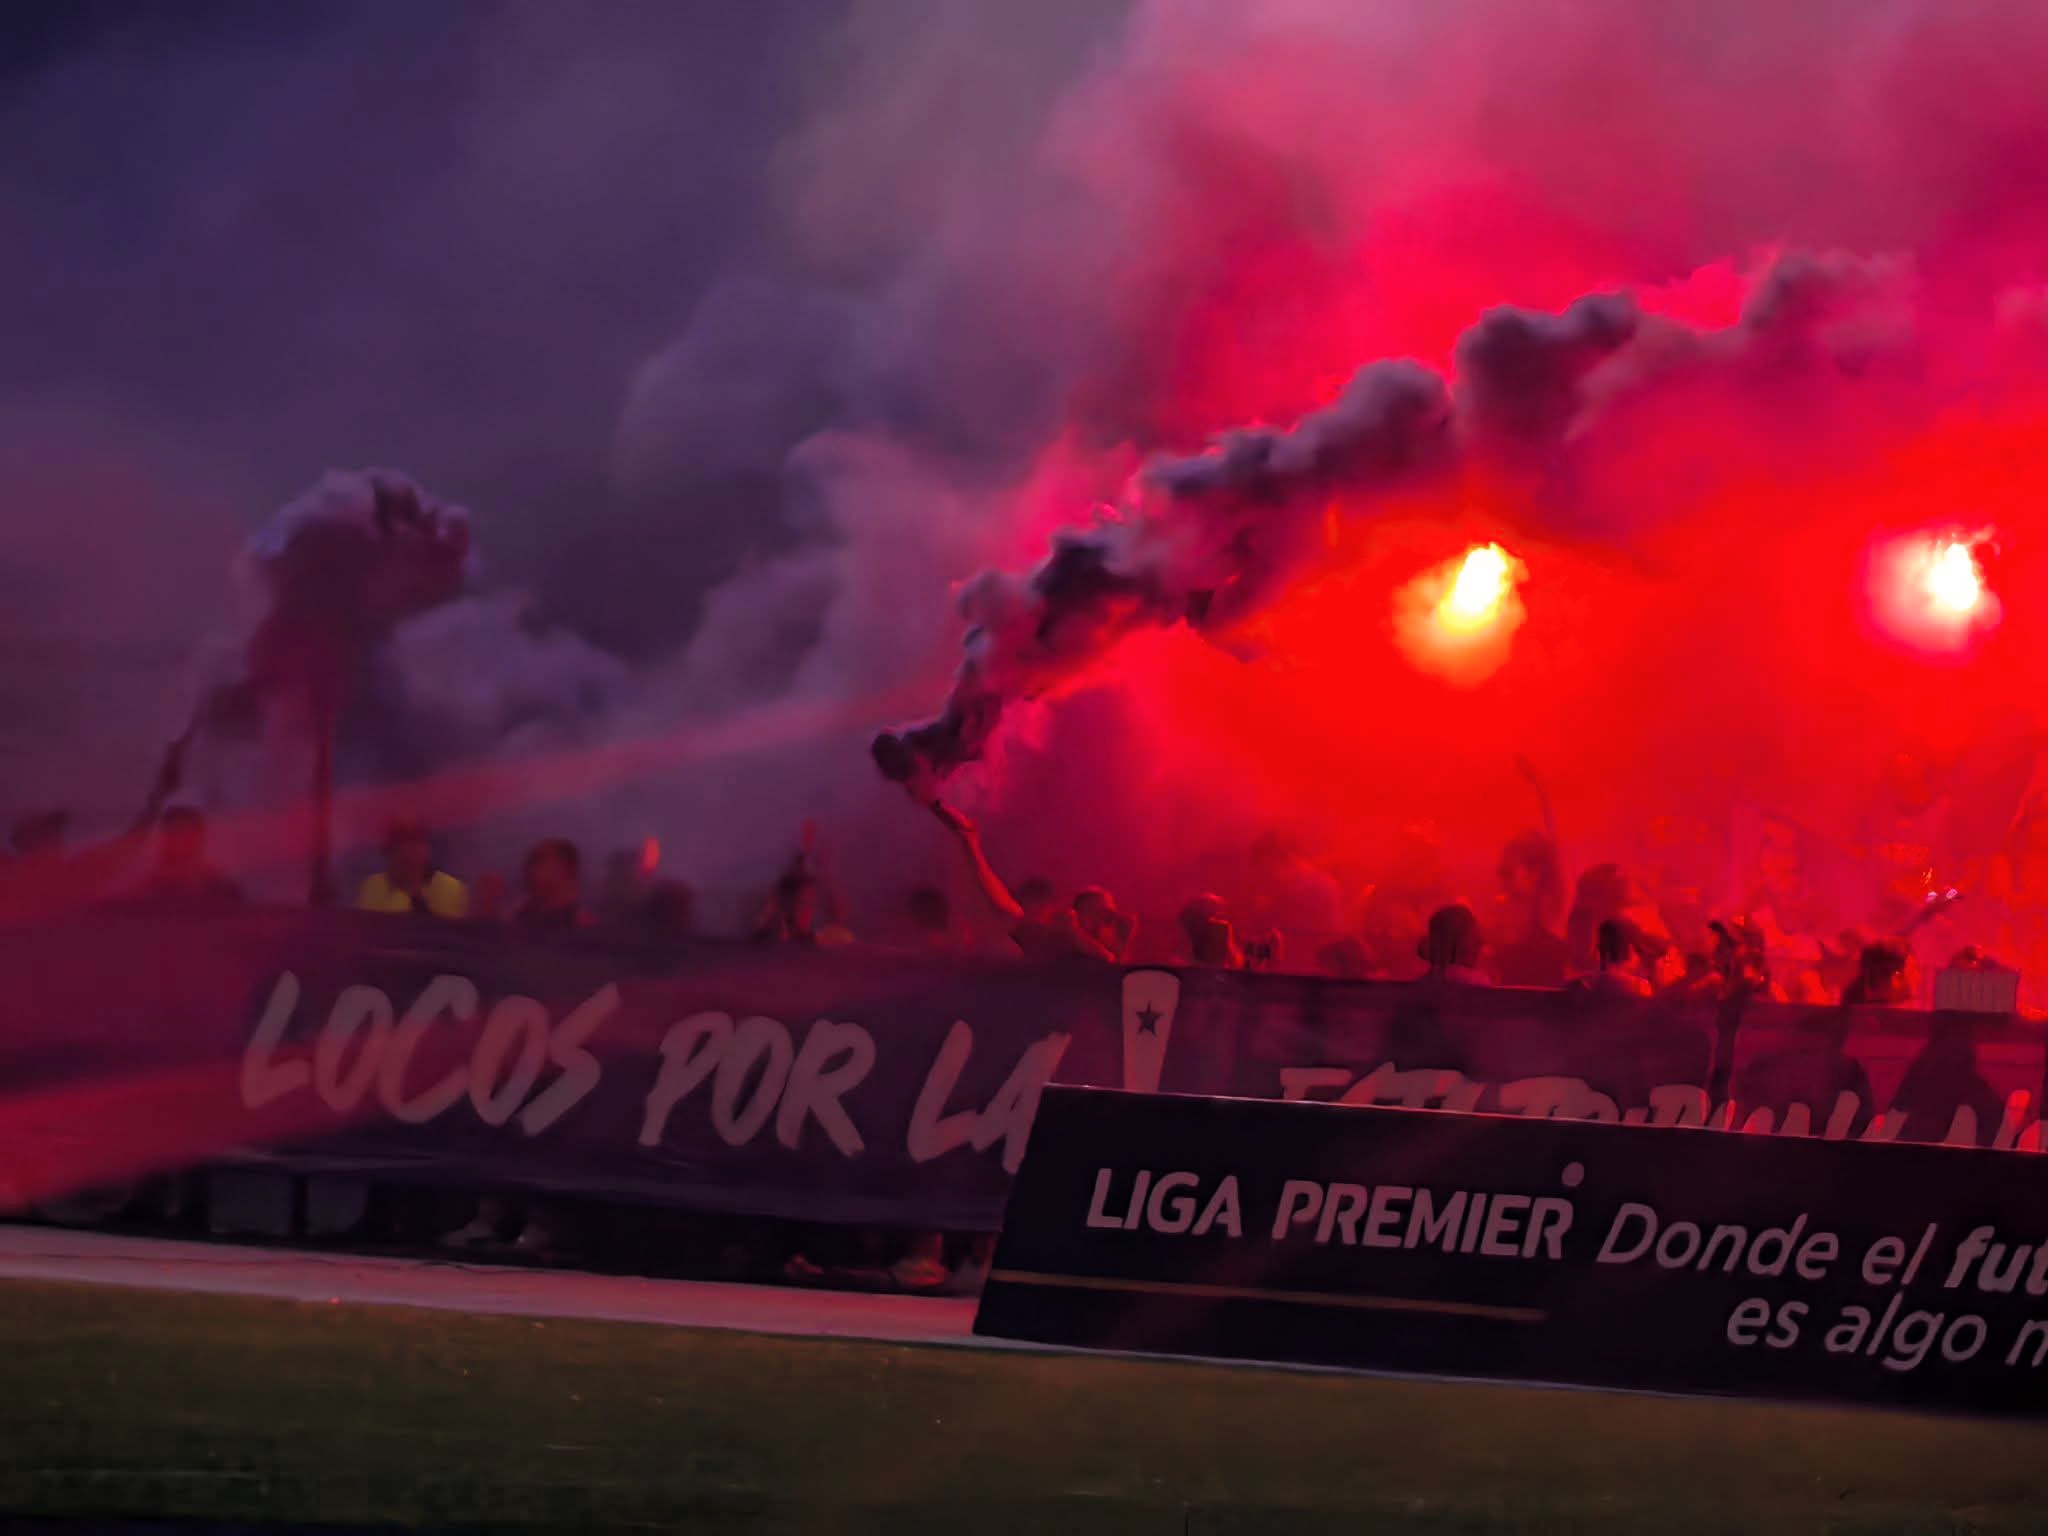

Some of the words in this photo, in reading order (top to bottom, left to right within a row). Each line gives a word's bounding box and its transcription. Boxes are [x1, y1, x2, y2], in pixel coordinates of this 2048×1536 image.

[240, 969, 622, 1136] LOCOS
[637, 1010, 877, 1158] POR
[905, 1019, 1072, 1175] LA
[1085, 1167, 1243, 1239] LIGA
[1270, 1178, 1575, 1261] PREMIER
[1595, 1202, 1840, 1281] Donde
[1860, 1222, 1940, 1286] el
[1726, 1296, 1810, 1349] es
[1823, 1290, 1988, 1371] algo
